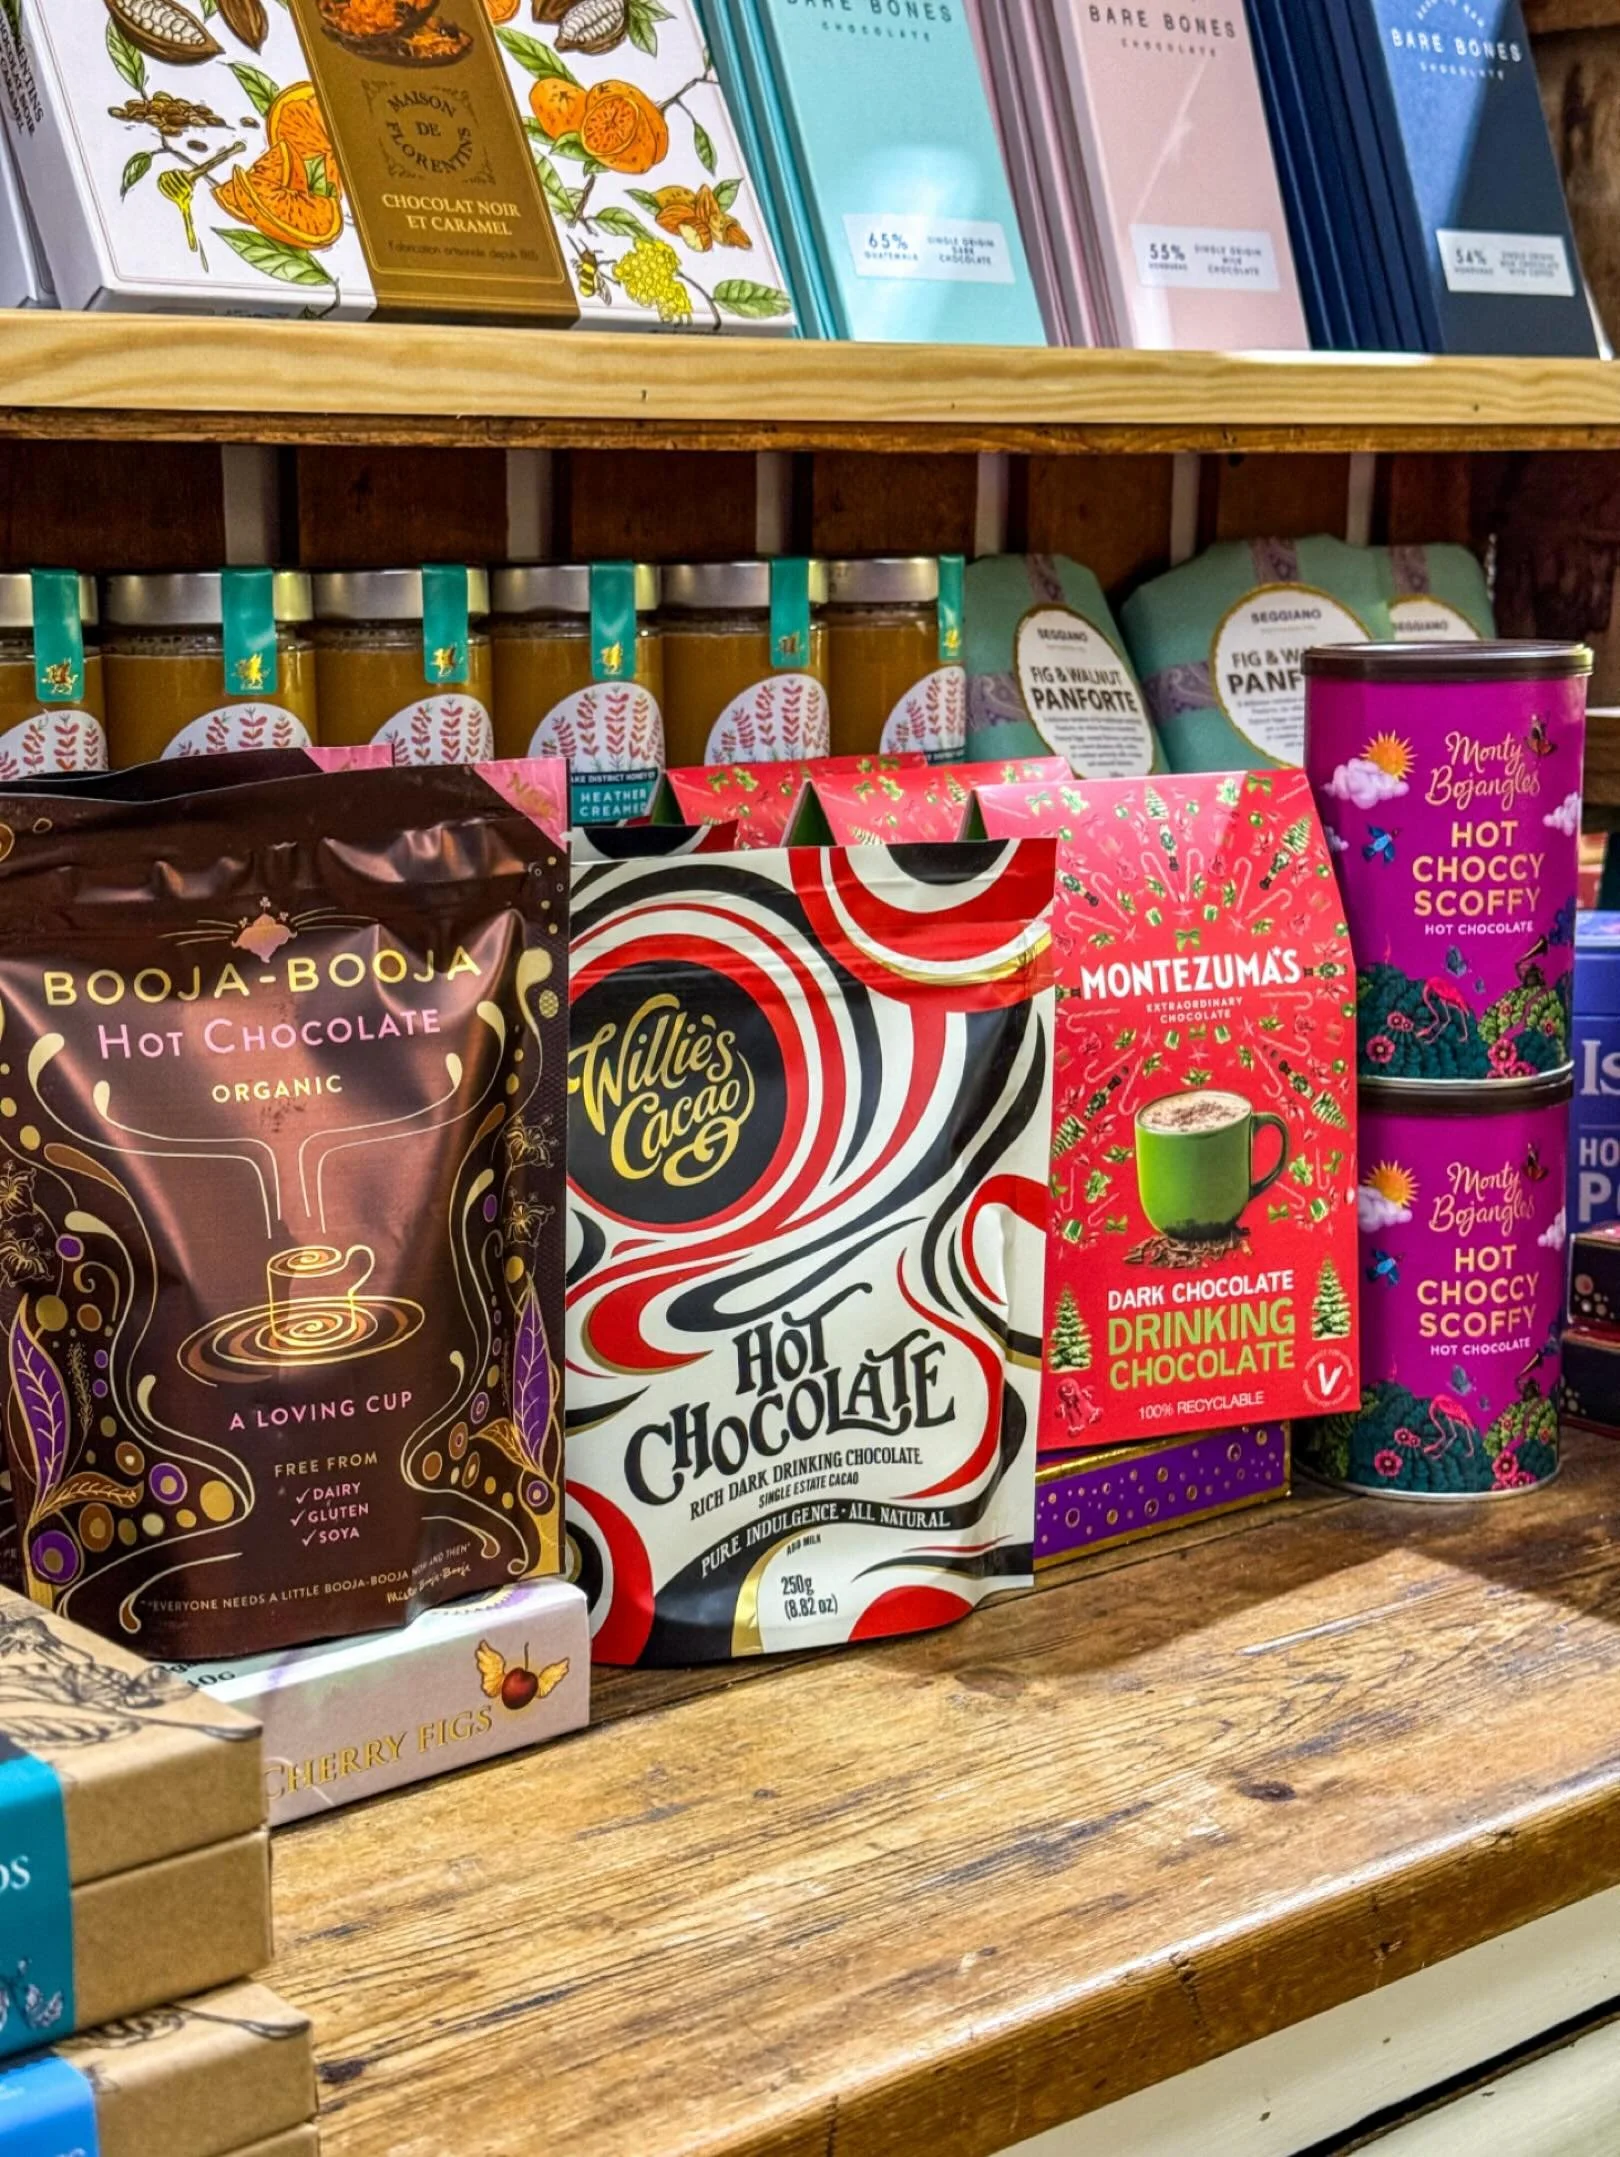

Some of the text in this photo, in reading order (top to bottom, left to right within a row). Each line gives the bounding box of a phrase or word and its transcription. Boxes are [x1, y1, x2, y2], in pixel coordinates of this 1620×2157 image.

[870, 0, 952, 22] BONES
[1089, 5, 1235, 38] BARE BONES
[822, 20, 930, 42] CHOCOLATE
[1391, 27, 1521, 62] BARE BONES
[387, 90, 457, 118] MAISON
[415, 120, 441, 136] DE
[386, 120, 473, 174] FLORENTINS
[382, 193, 521, 217] CHOCOLAT NOIR
[406, 215, 513, 235] ET CARAMEL
[868, 231, 909, 250] 65%
[1149, 243, 1186, 261] 55%
[1455, 248, 1488, 266] 54%
[1250, 608, 1322, 625] SEGGIANO
[1037, 627, 1088, 642] SEGGIANO
[1231, 650, 1262, 669] FIG
[1265, 648, 1278, 666] &
[1030, 666, 1122, 686] FIG & WALNUT
[1228, 669, 1303, 695] PANF
[1030, 687, 1138, 713] PANFORTE
[1445, 731, 1525, 776] Monty
[588, 773, 625, 783] DISTRICT
[1425, 763, 1541, 811] Bojangles
[581, 788, 647, 803] HEATHER
[1451, 820, 1519, 848] HOT
[1412, 853, 1545, 883] CHOCCY
[1413, 887, 1541, 917] SCOFFY
[1425, 920, 1533, 936] HOT CHOCOLATE
[44, 945, 482, 1007] BOOJA-BOOJA
[1080, 945, 1301, 1000] MONTEZUMA'S
[1146, 996, 1243, 1013] EXTRAORDINARY
[1160, 1008, 1231, 1024] CHOCOLATE
[568, 993, 736, 1136] Willie's
[211, 1075, 344, 1104] ORGANIC
[610, 1078, 745, 1186] Cacao
[1579, 1137, 1620, 1167] HO
[1446, 1161, 1521, 1201] Monty
[1428, 1190, 1535, 1237] Bojangles
[1455, 1244, 1517, 1273] HOT
[1107, 1269, 1294, 1311] DARK CHOCOLATE
[1417, 1272, 1540, 1305] CHOCCY
[1108, 1297, 1295, 1356] DRINKING
[1419, 1304, 1537, 1337] SCOFFY
[1430, 1337, 1531, 1356] HOT CHOCOLATE
[1109, 1340, 1295, 1391] CHOCOLATE
[1317, 1361, 1344, 1396] V
[229, 1391, 413, 1431] A LOVING CUP
[624, 1328, 956, 1505] CHOCOLATE
[1138, 1390, 1265, 1420] 100% RECYCLABLE
[274, 1451, 378, 1478] FREE FROM
[312, 1482, 361, 1502] DAIRY
[690, 1447, 923, 1521] RICH DARK DRINKING CHOCOLATE
[758, 1471, 859, 1509] SINGLE ESTATE CACAO
[308, 1503, 369, 1524] GLUTEN
[318, 1527, 361, 1544] SOYA
[702, 1502, 951, 1579] PURE INDULGENCE ALL NATURAL
[786, 1534, 822, 1556] ADD MILK
[223, 1594, 266, 1608] NEEDS
[268, 1592, 279, 1602] A
[281, 1584, 320, 1601] LITTLE
[324, 1570, 409, 1594] BOOJA-BOOJA
[780, 1574, 814, 1597] 250g
[784, 1593, 838, 1620] (8.82 oz)
[263, 1704, 493, 1800] CHERRY FIGS
